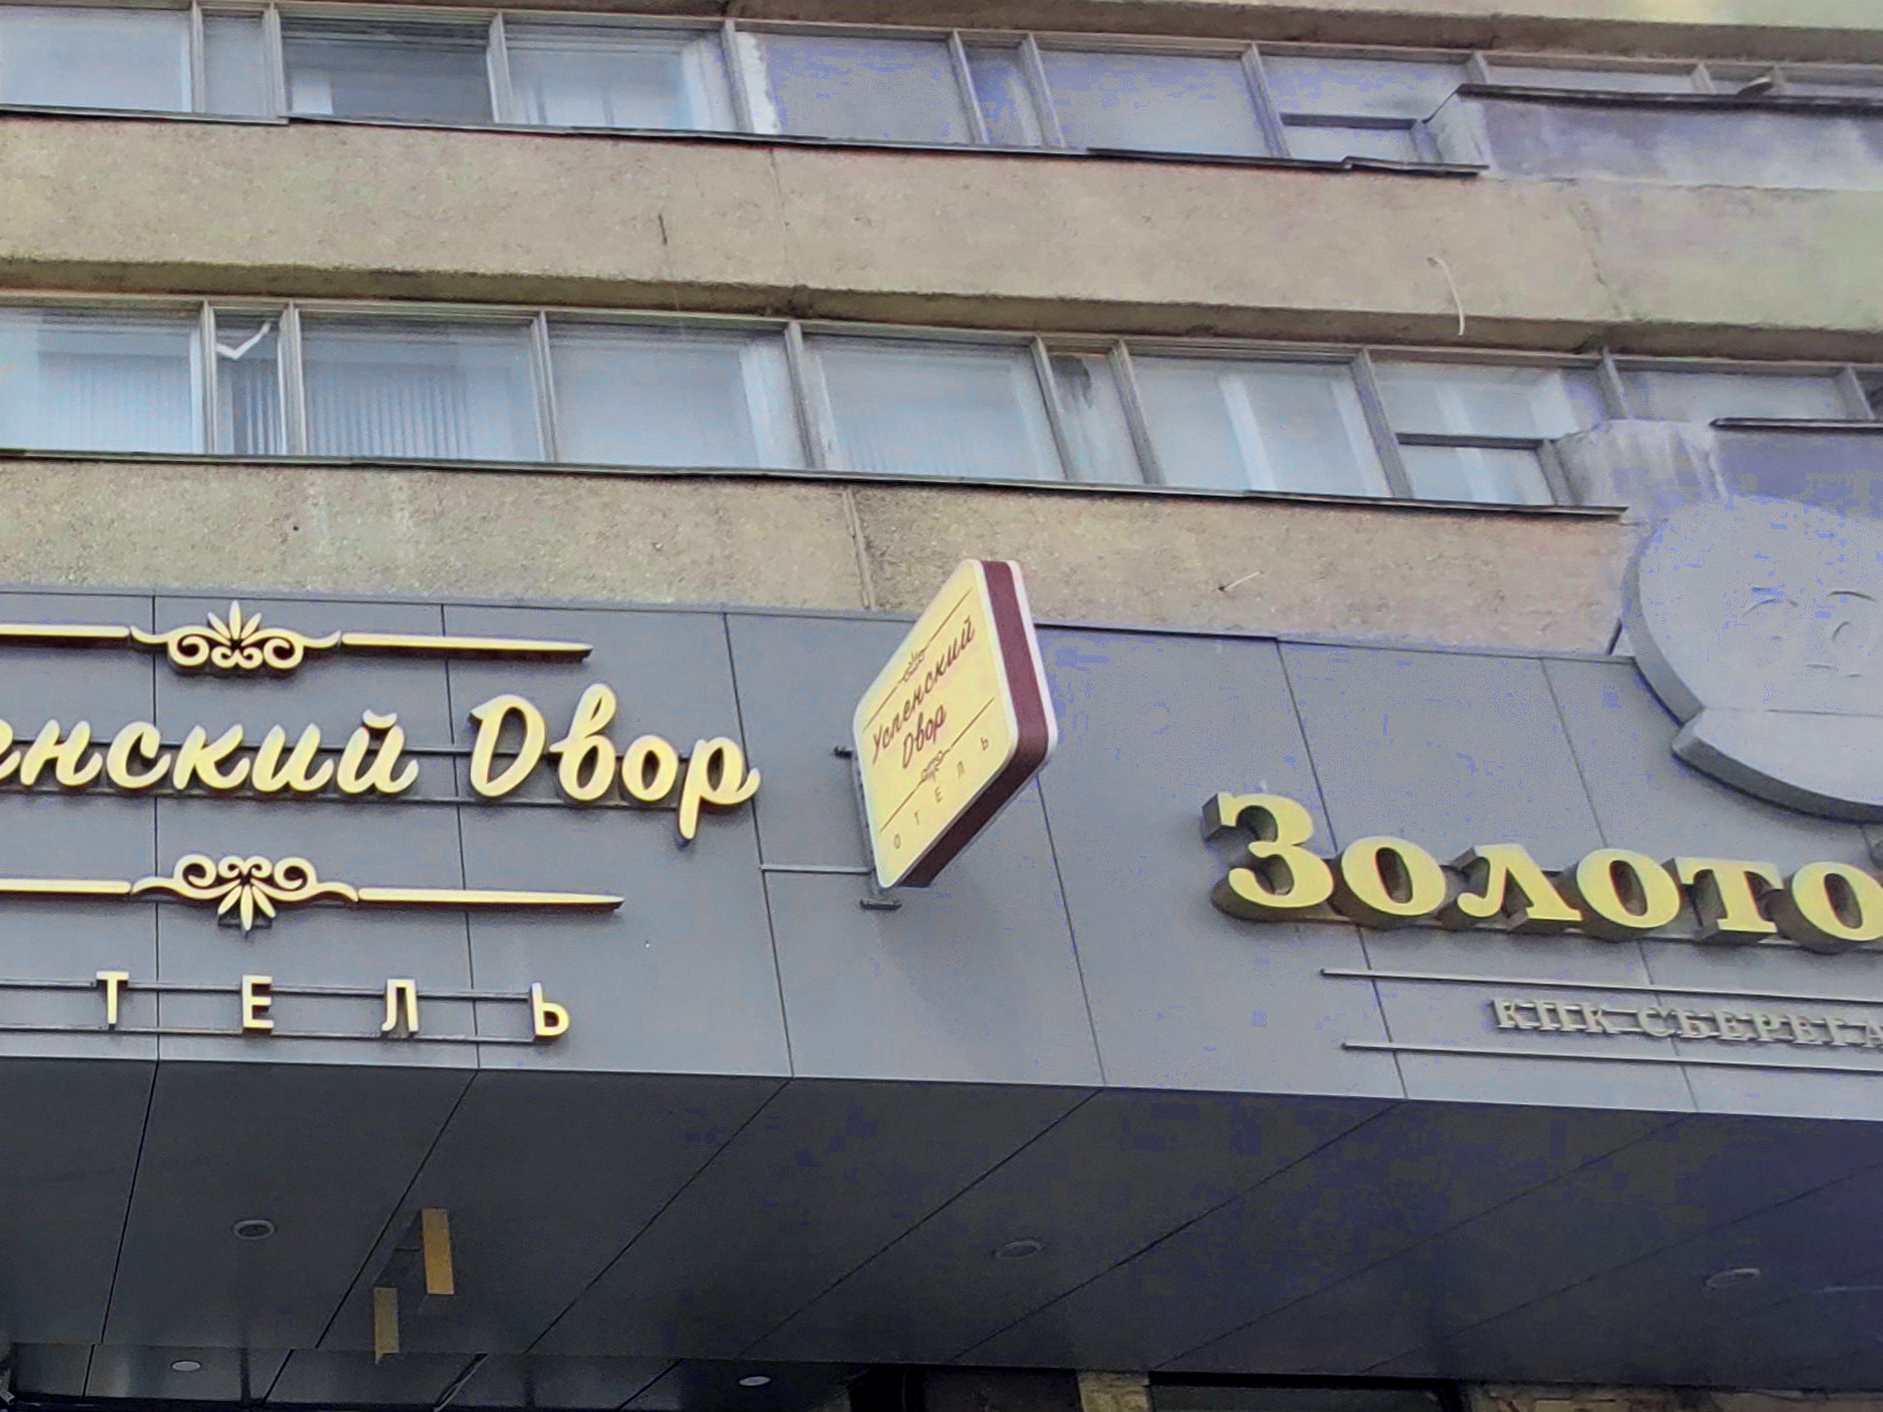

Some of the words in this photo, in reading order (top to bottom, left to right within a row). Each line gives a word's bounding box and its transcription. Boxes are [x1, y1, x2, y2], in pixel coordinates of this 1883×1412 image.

[467, 682, 762, 843] Двор
[872, 614, 977, 765] Успенский
[902, 704, 948, 770] Двор
